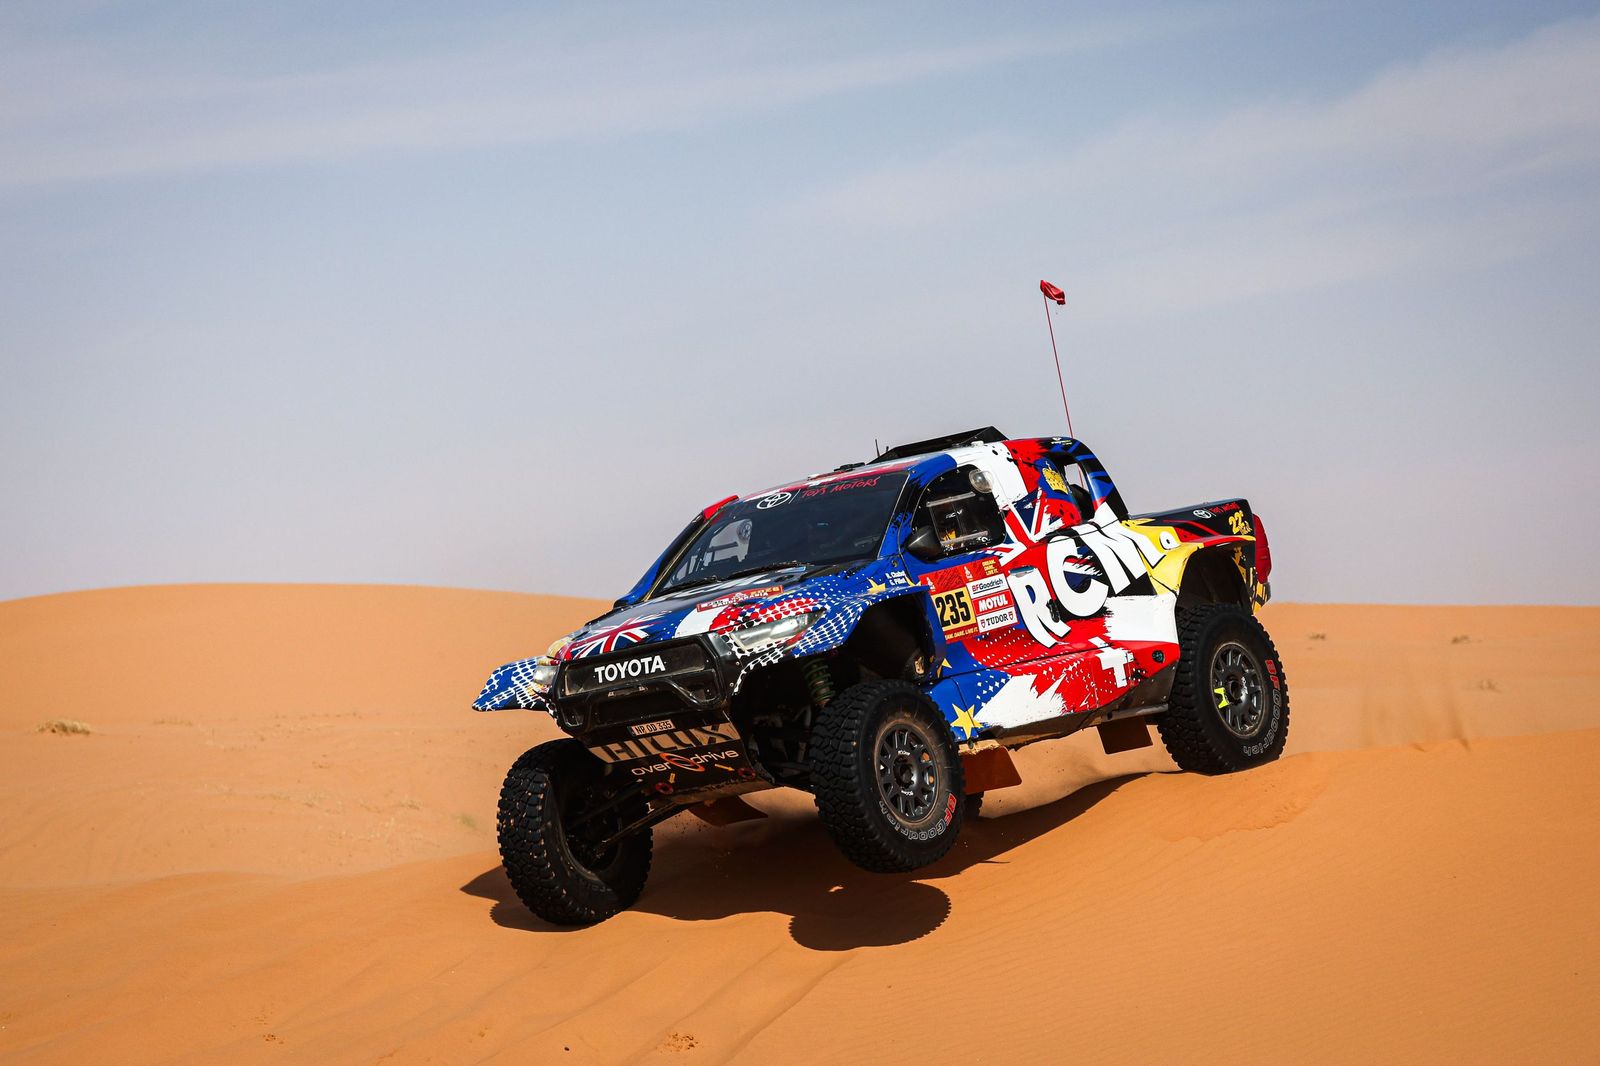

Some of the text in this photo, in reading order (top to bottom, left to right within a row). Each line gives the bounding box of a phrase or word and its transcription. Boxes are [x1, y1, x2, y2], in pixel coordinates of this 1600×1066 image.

[830, 476, 881, 493] MOTORS
[971, 577, 1004, 593] BFGoodrich
[1007, 501, 1166, 648] RCM
[935, 590, 972, 627] 235
[978, 594, 1009, 612] MOTUL
[986, 613, 1009, 627] TUDOR
[594, 655, 666, 683] TOYOTA
[1243, 659, 1282, 756] BFGoodrich
[656, 720, 672, 730] 335
[600, 723, 735, 762] HILUX
[631, 750, 739, 776] over drive
[879, 792, 957, 841] BFGoodrich
